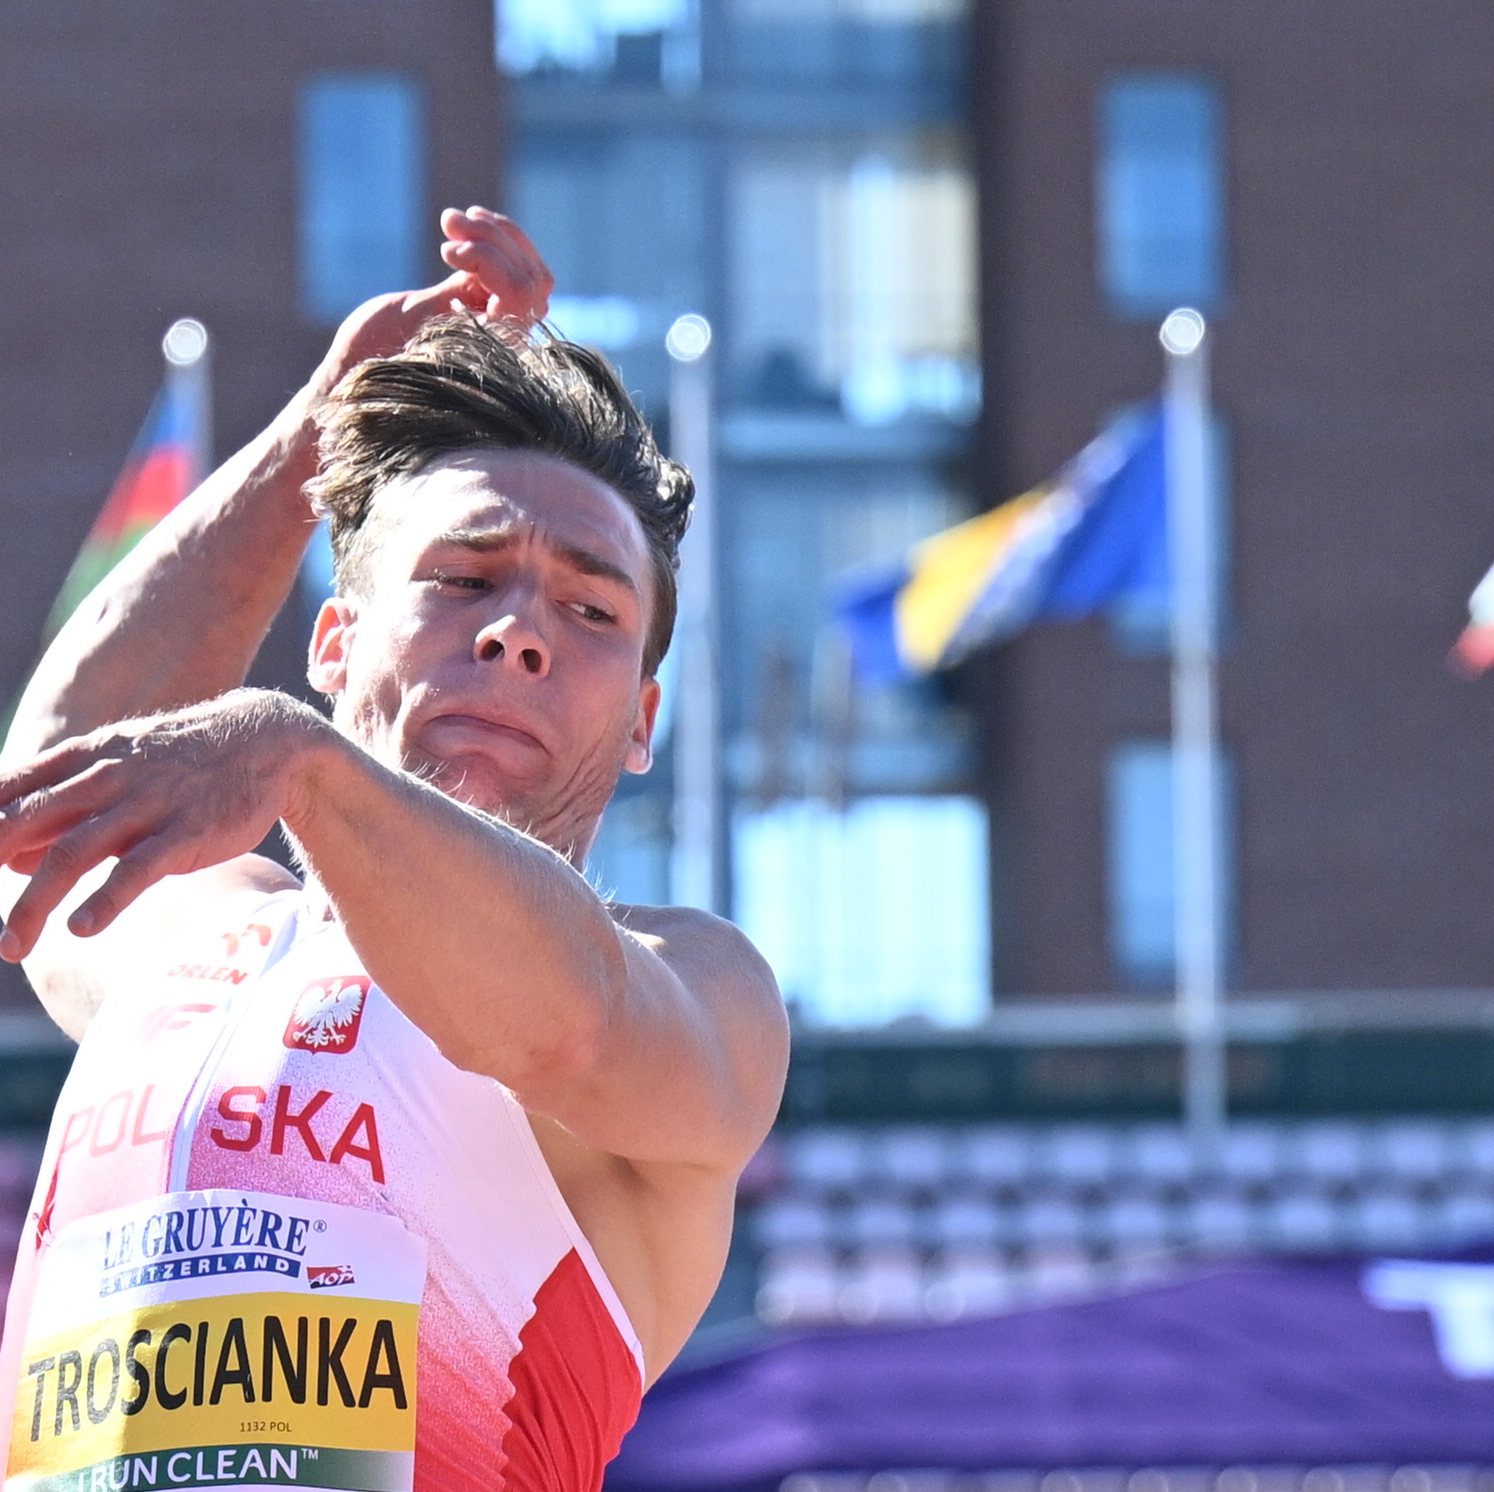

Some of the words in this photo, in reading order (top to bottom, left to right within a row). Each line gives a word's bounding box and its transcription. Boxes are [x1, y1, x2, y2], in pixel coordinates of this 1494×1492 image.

[167, 963, 249, 985] ORLEN
[102, 1220, 136, 1271] LE
[101, 1254, 290, 1294] SWITZERLAND
[27, 1315, 408, 1442] TROSCIANKA
[240, 1421, 266, 1432] 1132
[269, 1421, 292, 1433] POL
